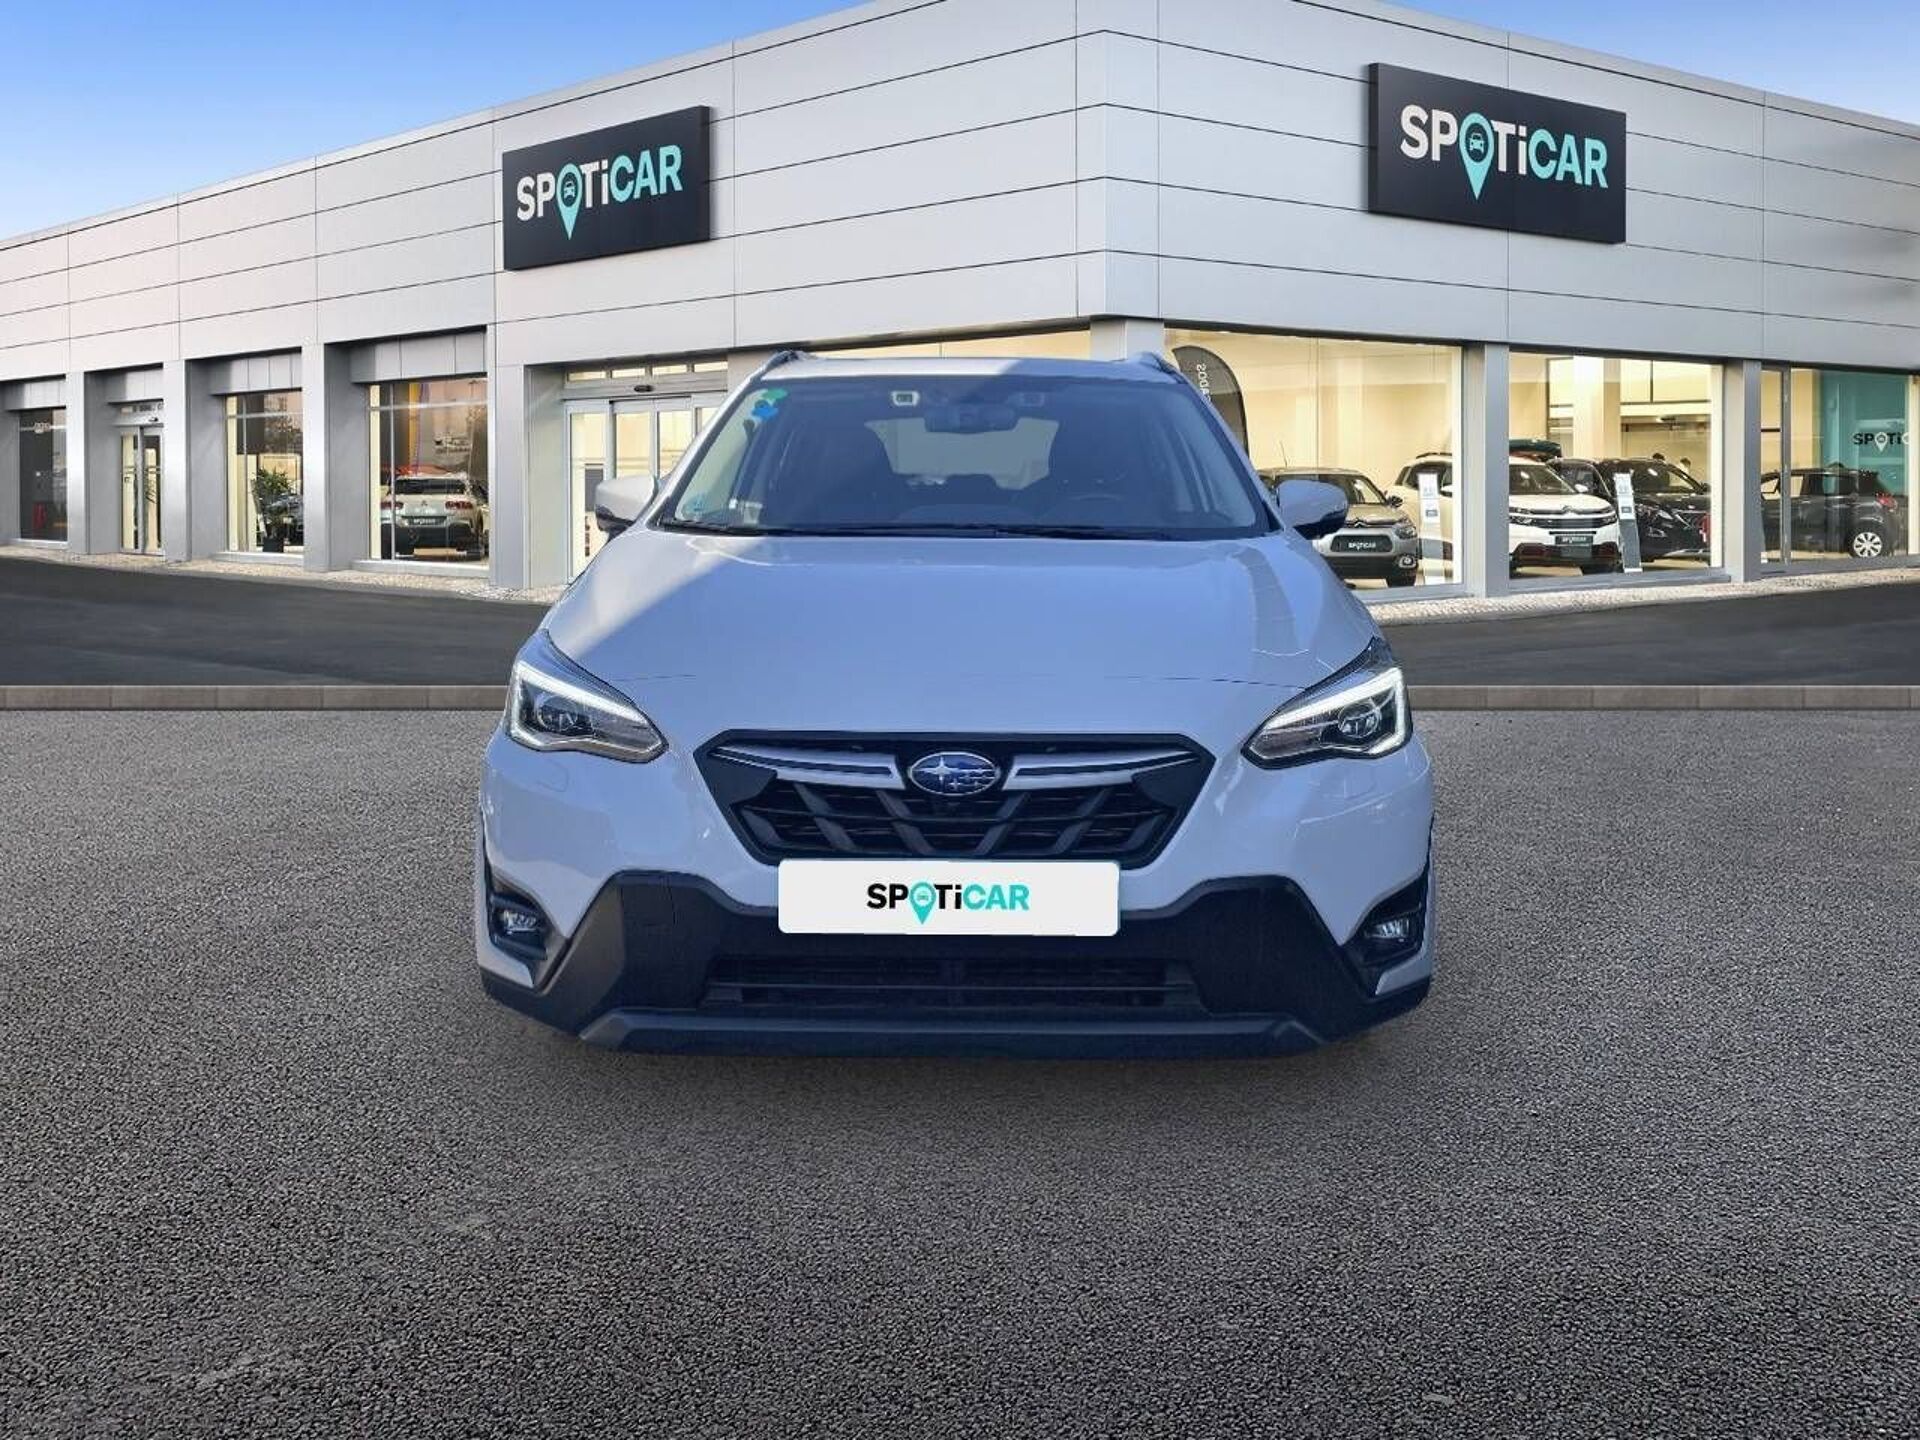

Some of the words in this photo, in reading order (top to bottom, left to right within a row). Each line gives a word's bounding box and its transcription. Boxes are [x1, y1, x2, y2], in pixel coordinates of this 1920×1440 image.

[516, 145, 683, 240] SPOTiCAR
[1400, 104, 1608, 200] SPOTiCAR
[866, 882, 1030, 925] SPOTiCAR
